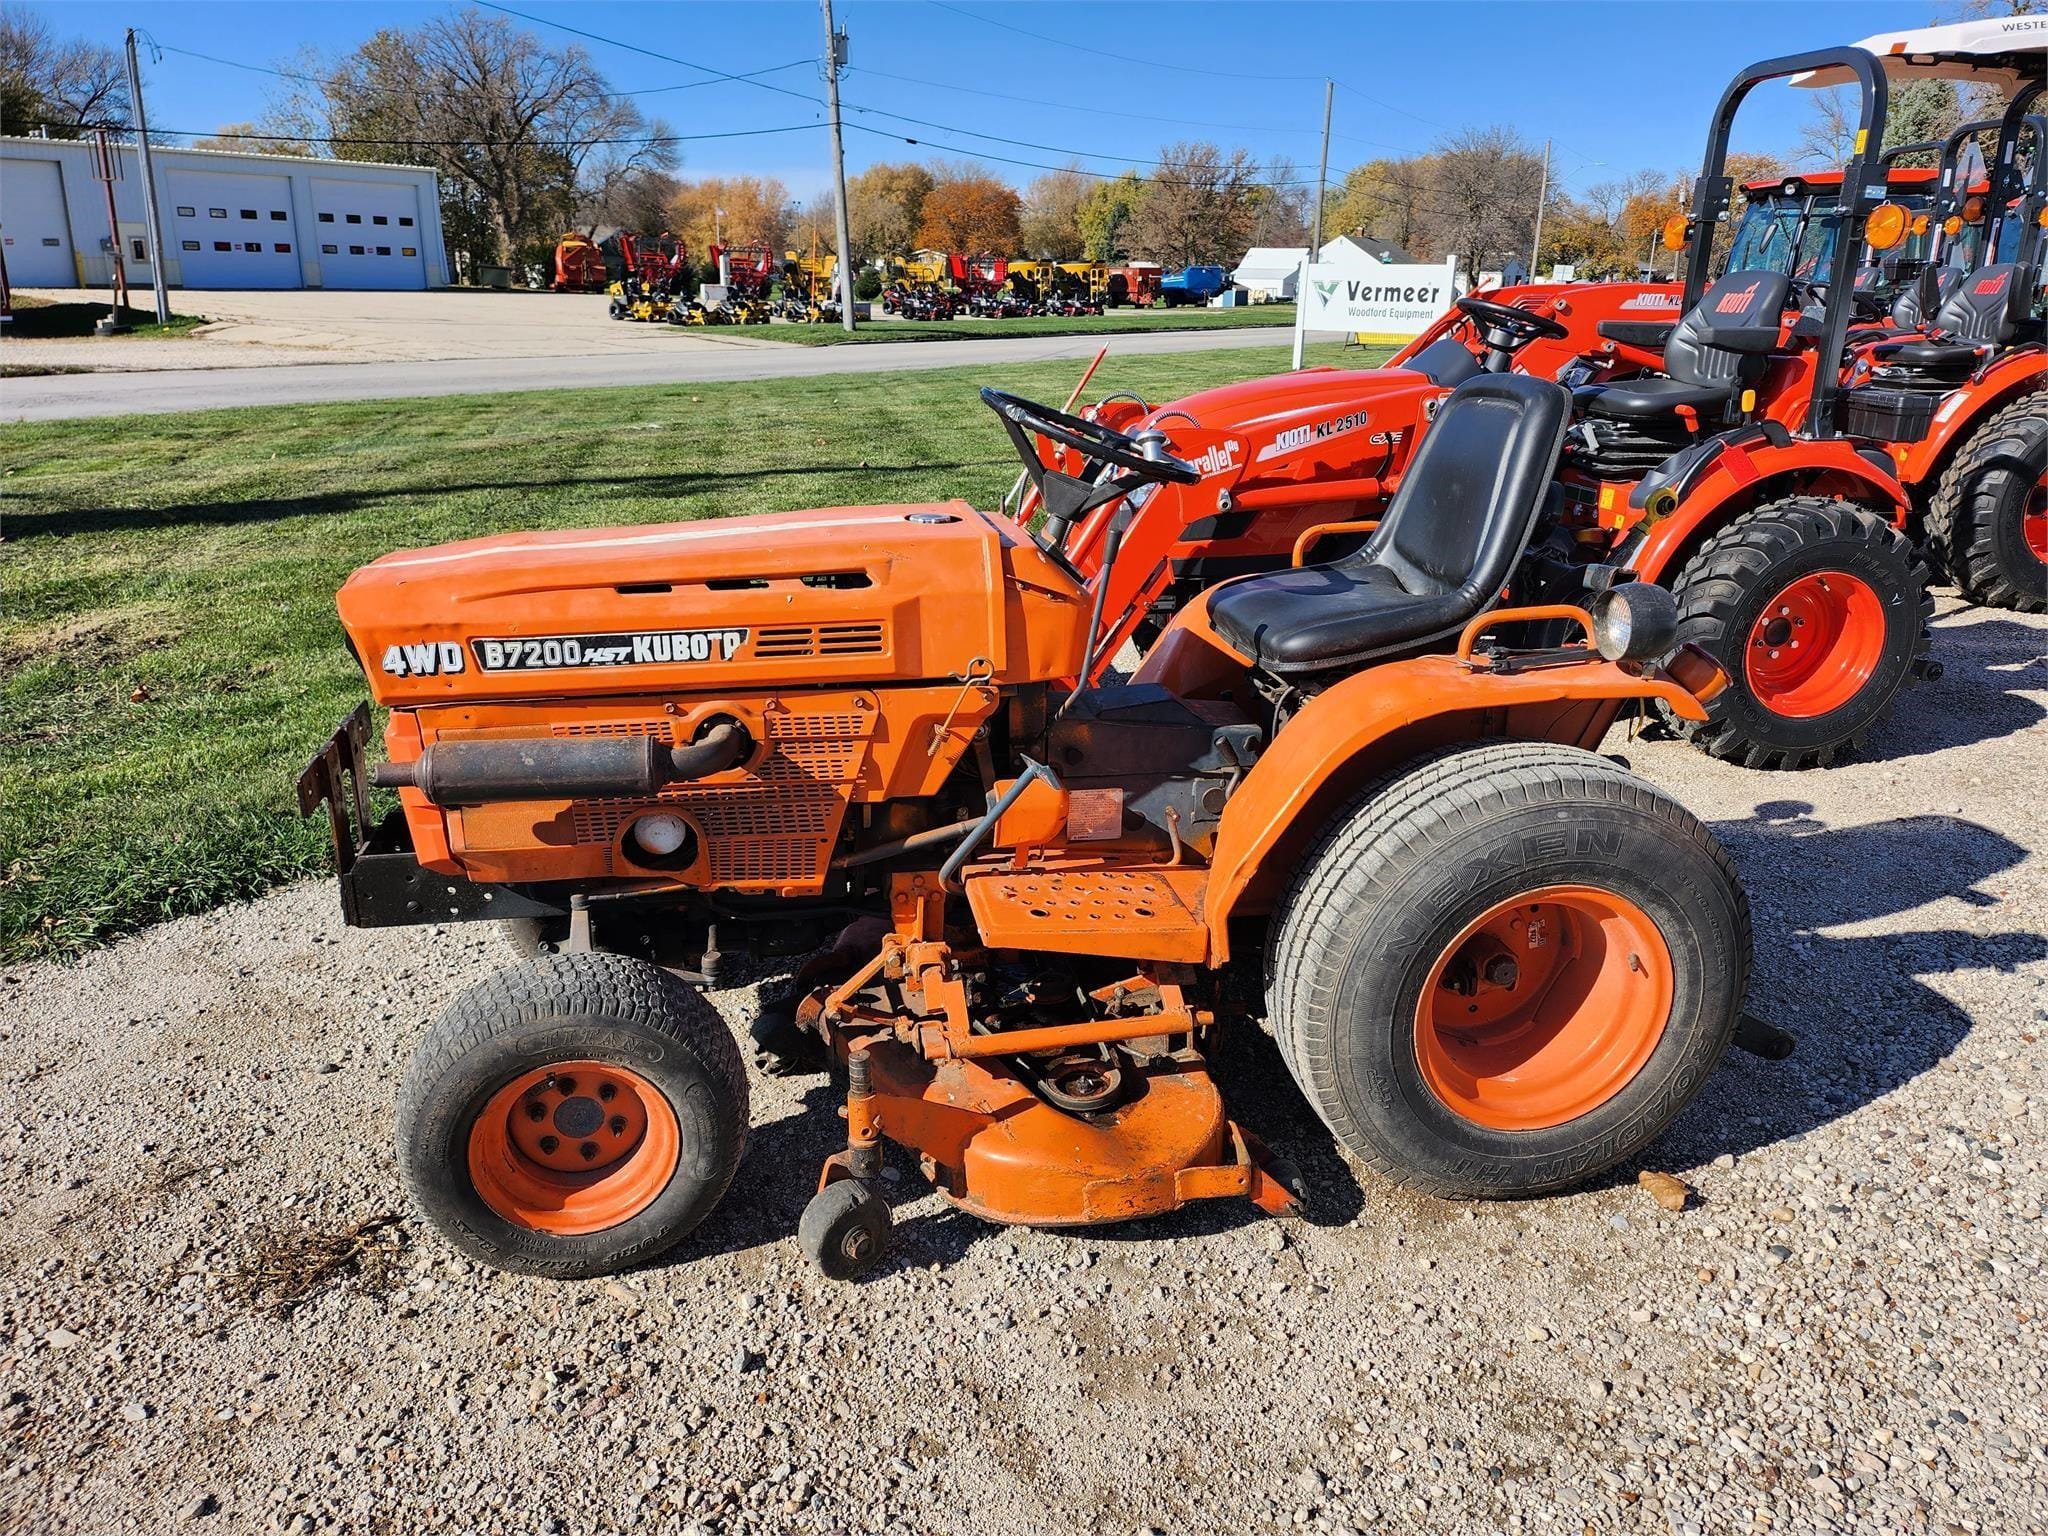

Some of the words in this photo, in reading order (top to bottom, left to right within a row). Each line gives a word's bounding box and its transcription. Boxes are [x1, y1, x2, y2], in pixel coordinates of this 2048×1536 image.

[1347, 280, 1440, 303] Vermeer
[1635, 293, 1665, 306] KIOTI
[1667, 295, 1680, 306] KL
[1715, 285, 1758, 313] KIOTI
[1348, 307, 1387, 318] Woodford
[1389, 308, 1433, 320] Equipment
[1276, 424, 1311, 451] KIOTI
[1316, 421, 1333, 438] KL
[1336, 411, 1367, 432] 2510
[382, 641, 466, 678] 4WD
[484, 639, 581, 669] B7200
[582, 647, 633, 662] HST
[1382, 828, 1625, 968] NEXEN
[542, 1027, 644, 1054] TITAN
[1529, 1027, 1718, 1184] ROADIAN
